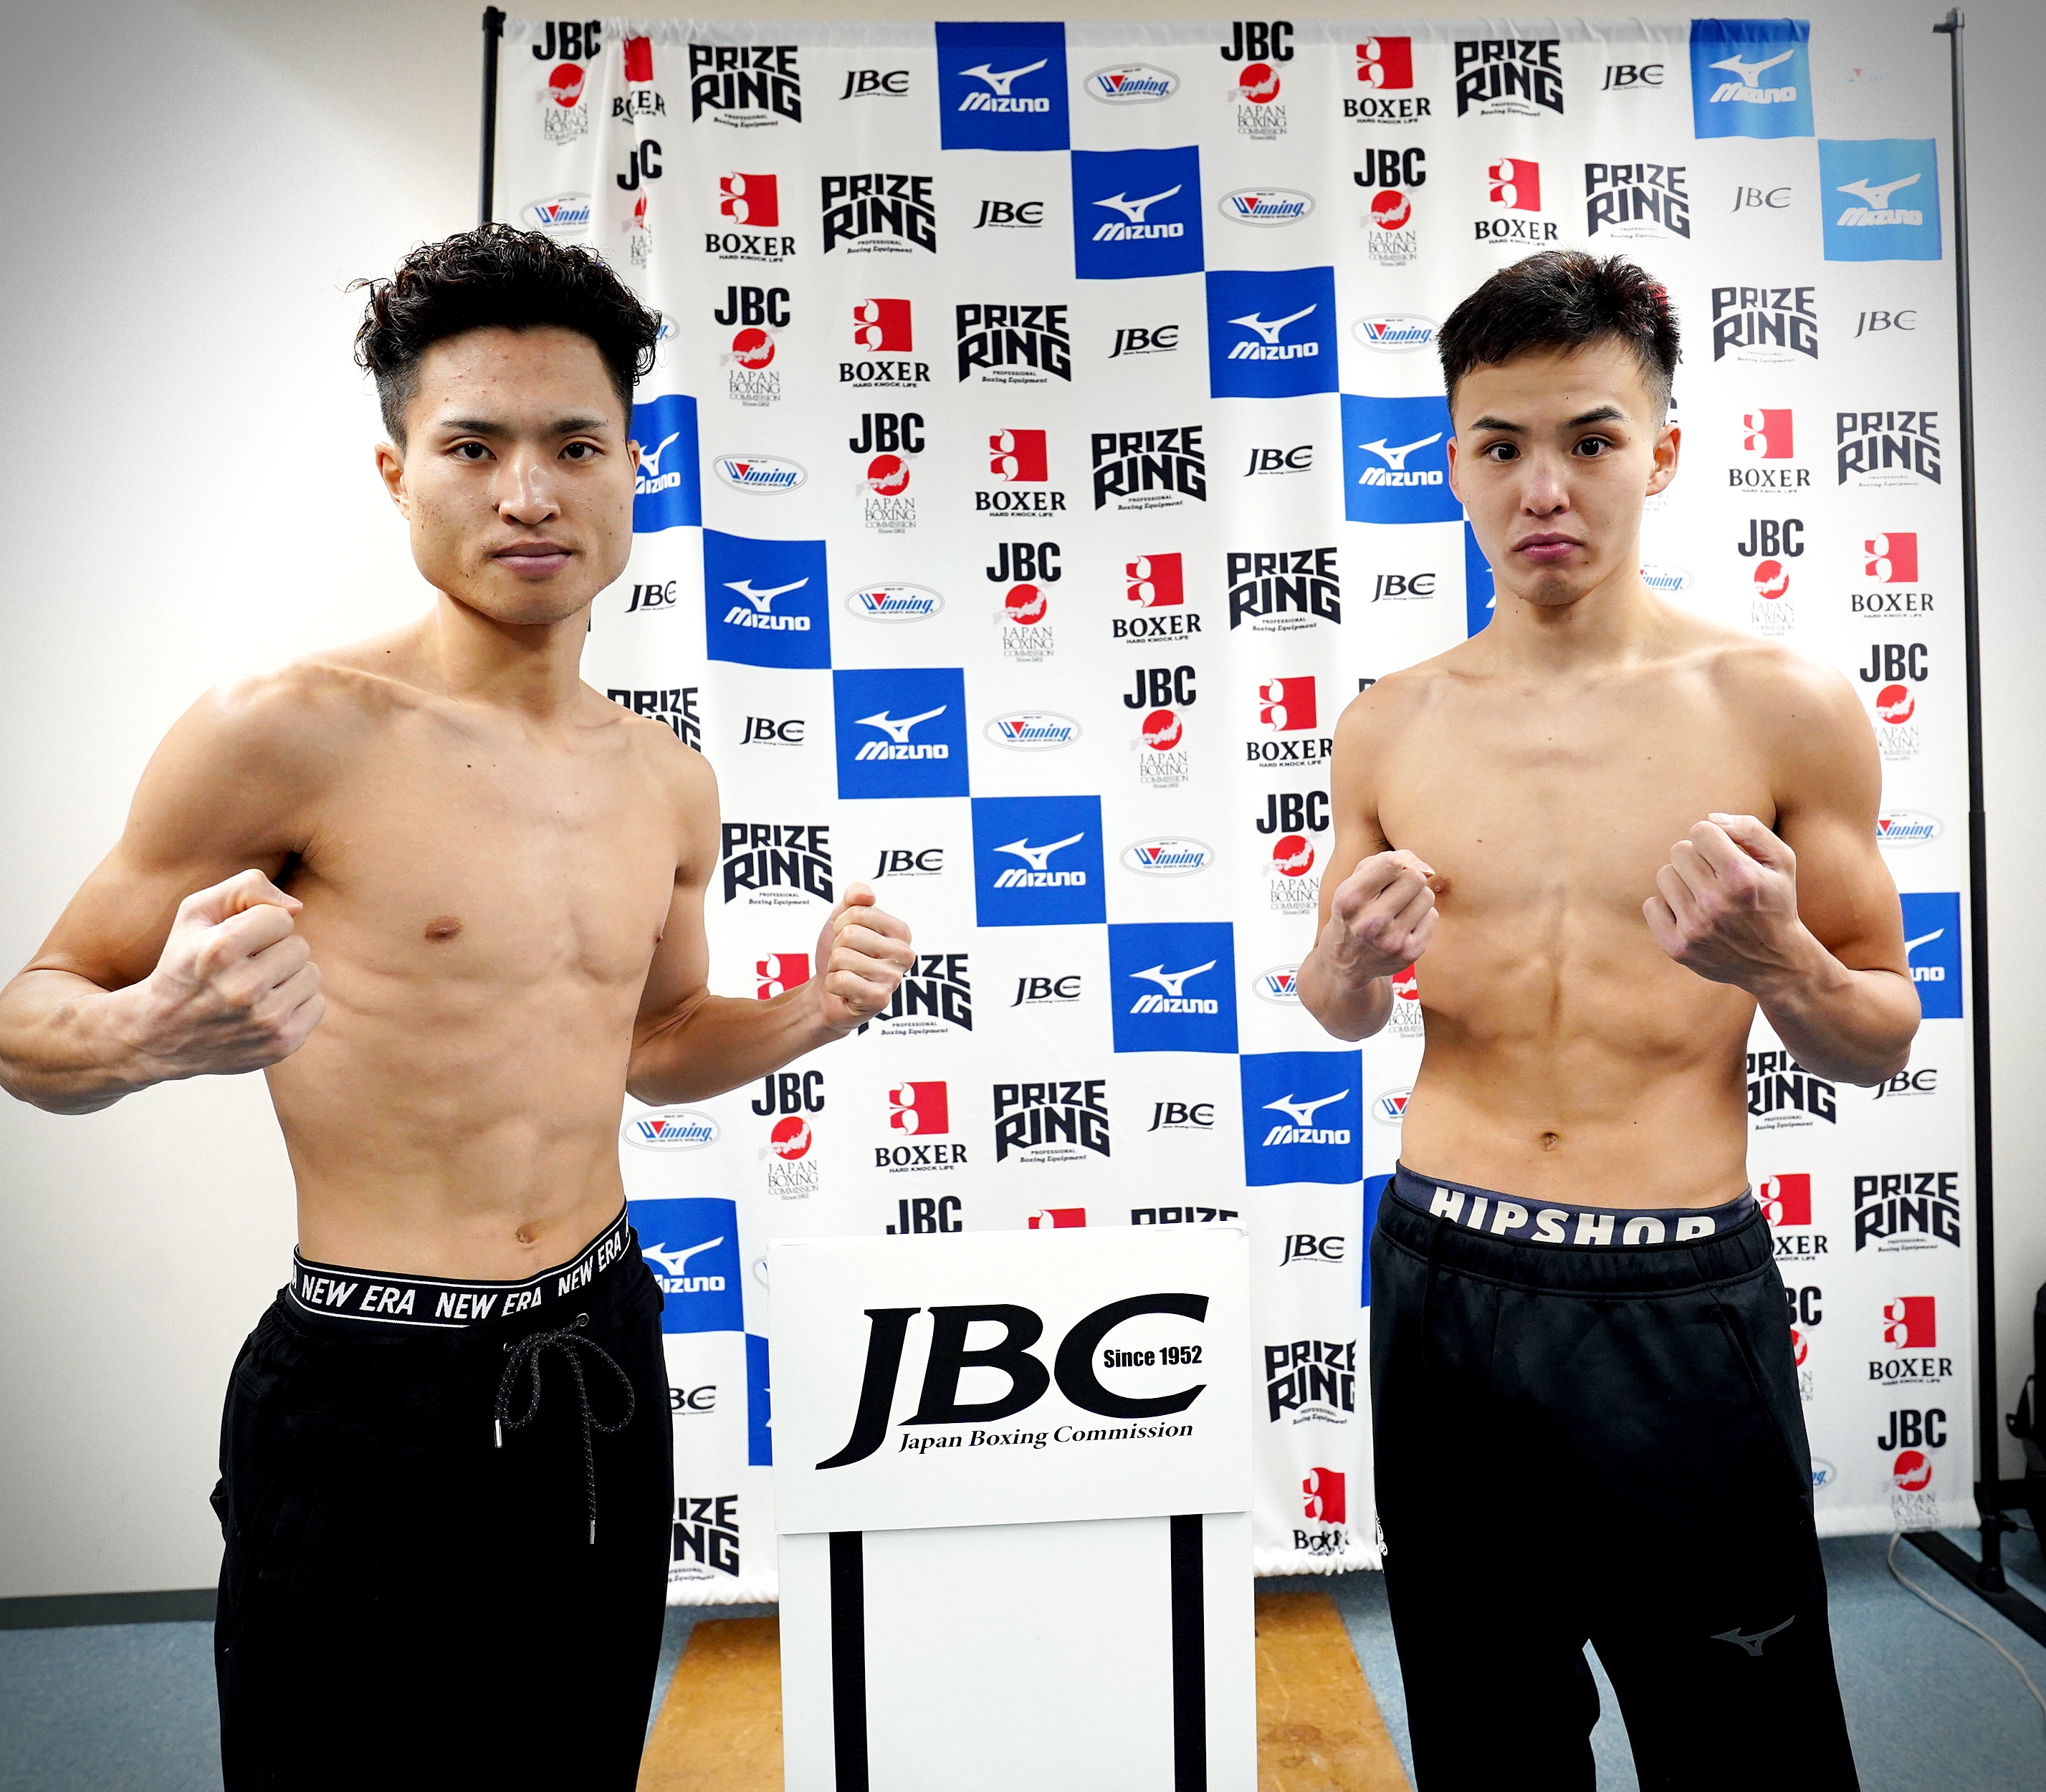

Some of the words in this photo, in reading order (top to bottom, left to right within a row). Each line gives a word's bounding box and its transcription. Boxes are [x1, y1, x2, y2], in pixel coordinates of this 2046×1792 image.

[532, 19, 601, 60] JBC
[1221, 21, 1294, 61] JBC
[689, 44, 799, 81] PRIZE
[1455, 39, 1561, 77] PRIZE
[841, 70, 909, 100] JBC
[1097, 75, 1169, 95] Winning
[1456, 62, 1563, 117] RING
[1602, 64, 1663, 90] JBC
[692, 72, 801, 123] RING
[1238, 105, 1285, 117] JAPAN
[1344, 98, 1430, 118] BOXER
[1238, 115, 1286, 128] BOXING
[1354, 148, 1425, 187] JBC
[1585, 163, 1688, 199] PRIZE
[821, 173, 934, 212] PRIZE
[1232, 197, 1304, 217] Winning
[1733, 187, 1791, 211] JBC
[823, 197, 936, 253] RING
[974, 201, 1043, 229] JBC
[1587, 187, 1690, 239] RING
[706, 234, 795, 255] BOXER
[1369, 231, 1415, 242] JAPAN
[1475, 219, 1557, 239] BOXER
[1369, 241, 1416, 254] BOXING
[714, 287, 790, 327] JBC
[1712, 287, 1816, 322] PRIZE
[956, 305, 1069, 340] PRIZE
[1363, 323, 1432, 343] Winning
[1713, 312, 1817, 362] RING
[1856, 310, 1916, 337] JBC
[958, 329, 1071, 382] RING
[1109, 325, 1178, 358] JBC
[730, 370, 779, 383] JAPAN
[840, 362, 930, 382] BOXER
[730, 382, 780, 394] BOXING
[850, 413, 924, 453] JBC
[1837, 411, 1939, 445] PRIZE
[1091, 426, 1204, 469] PRIZE
[1245, 446, 1312, 476] JBC
[1838, 435, 1941, 485] RING
[724, 461, 797, 487] Winning
[1094, 454, 1206, 510] RING
[1730, 469, 1810, 487] BOXER
[865, 498, 914, 509] JAPAN
[865, 509, 915, 521] BOXING
[975, 492, 1066, 510] BOXER
[1739, 519, 1804, 557] JBC
[987, 542, 1061, 582] JBC
[1227, 547, 1339, 588] PRIZE
[626, 581, 676, 613] JBC
[1229, 576, 1341, 630] RING
[1372, 573, 1435, 602] JBC
[1852, 594, 1933, 611] BOXER
[859, 593, 933, 614] Winning
[1003, 627, 1052, 638] JAPAN
[1113, 614, 1201, 637] BOXER
[1003, 638, 1053, 650] BOXING
[1860, 643, 1928, 682] JBC
[1124, 666, 1196, 709] JBC
[741, 717, 804, 744] JBC
[998, 722, 1071, 742] Winning
[1139, 752, 1187, 765] JAPAN
[1247, 739, 1332, 760] BOXER
[1140, 763, 1187, 776] BOXING
[1256, 791, 1329, 833] JBC
[722, 823, 831, 861] PRIZE
[1134, 848, 1204, 867] Winning
[724, 849, 833, 904] RING
[874, 849, 942, 878] JBC
[1271, 878, 1319, 891] JAPAN
[902, 954, 970, 990] IZE
[1011, 976, 1081, 1007] JBC
[858, 979, 972, 1036] ING
[752, 1070, 825, 1116] JBC
[993, 1080, 1107, 1121] PRIZE
[636, 1121, 712, 1142] Winning
[1148, 1103, 1214, 1131] JBC
[995, 1107, 1110, 1162] RING
[768, 1160, 817, 1175] JAPAN
[875, 1144, 967, 1166] BOXER
[768, 1172, 818, 1187] BOXING
[1855, 1172, 1959, 1211] PRIZE
[886, 1196, 962, 1235] JBC
[1855, 1197, 1960, 1252] RING
[1280, 1235, 1344, 1266] JBC
[1775, 1235, 1828, 1255] XER
[302, 1274, 357, 1307] NEW
[359, 1286, 416, 1316] ERA
[435, 1292, 498, 1319] NEW
[558, 1260, 593, 1297] NEW
[598, 1236, 622, 1272] ERA
[1784, 1286, 1822, 1326] BC
[1104, 1348, 1155, 1368] Since
[1160, 1345, 1203, 1365] 1952
[1870, 1359, 1952, 1379] BOXER
[815, 1293, 1209, 1470] JBC
[898, 1433, 962, 1455] Japan
[968, 1429, 1049, 1450] Boxing
[1053, 1422, 1194, 1443] Commission
[1878, 1409, 1946, 1451] JBC
